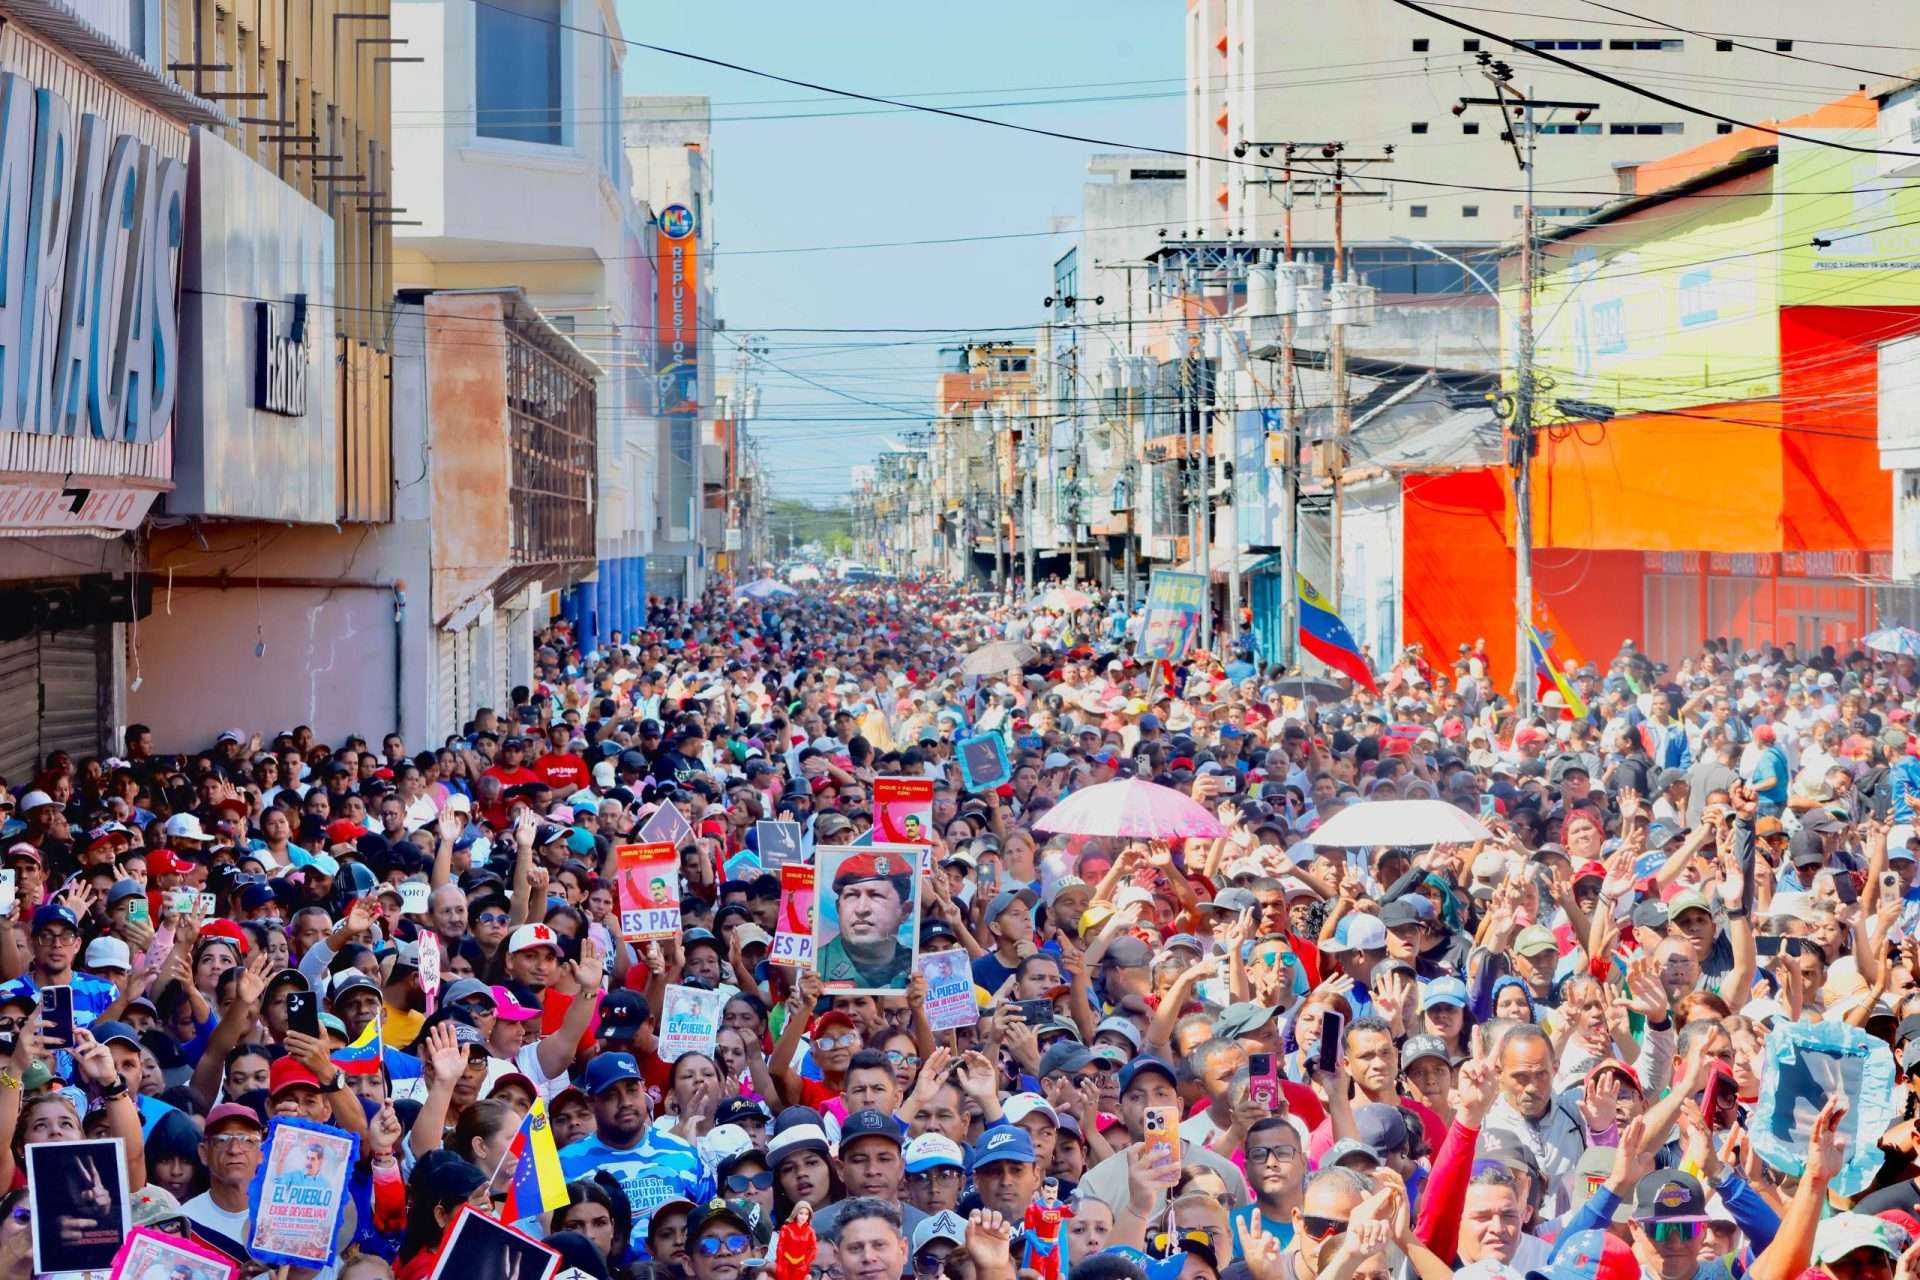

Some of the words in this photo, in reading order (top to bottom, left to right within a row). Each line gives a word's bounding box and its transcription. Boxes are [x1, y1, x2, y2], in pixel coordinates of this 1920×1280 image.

[672, 246, 684, 366] REPUESTOS
[623, 913, 642, 932] ES
[650, 910, 680, 930] PAZ
[774, 936, 794, 955] ES
[937, 980, 969, 998] PUEBLO
[681, 1022, 712, 1034] PUEBLO
[991, 1134, 1014, 1143] NIKE
[619, 1178, 656, 1190] DORES
[272, 1186, 287, 1203] EL
[288, 1187, 332, 1206] PUEBLO
[635, 1196, 670, 1209] PATR
